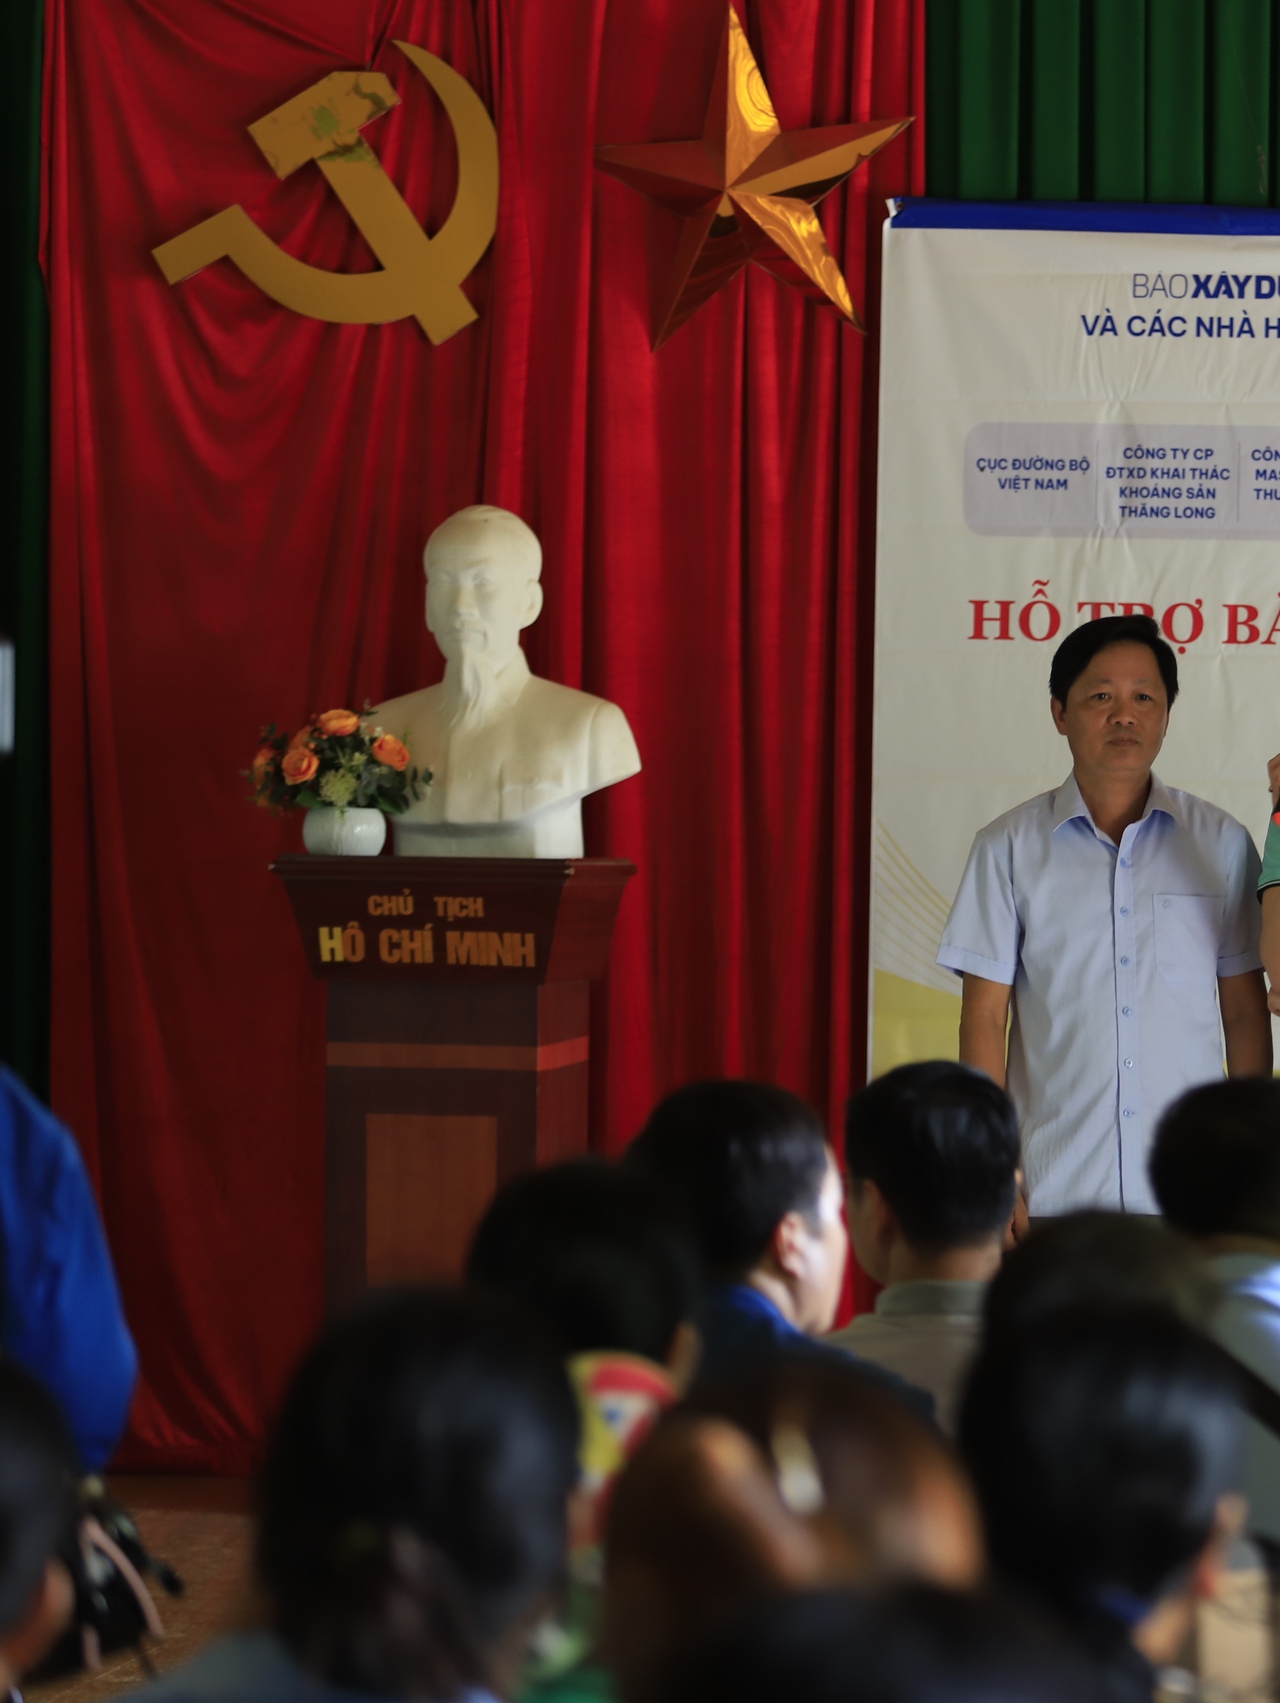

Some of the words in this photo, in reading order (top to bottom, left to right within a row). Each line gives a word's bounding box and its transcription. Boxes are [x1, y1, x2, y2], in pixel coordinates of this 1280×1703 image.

[1081, 308, 1118, 337] VÀ
[1127, 309, 1187, 338] CÁC
[1196, 309, 1255, 339] NHÀ
[1123, 446, 1167, 460] CÔNG
[1170, 449, 1190, 460] TY
[1193, 449, 1214, 461] CP
[976, 457, 1008, 474] CỤC
[1011, 456, 1066, 471] ĐƯỜNG
[1069, 456, 1090, 475] BỘ
[1105, 467, 1147, 479] ĐTXD
[1150, 468, 1186, 480] KHAI
[1189, 465, 1231, 481] THÁC
[998, 476, 1031, 493] VIỆT
[1034, 478, 1068, 490] NAM
[1119, 484, 1182, 500] KHOÁNG
[1185, 483, 1216, 500] SẢN
[1119, 503, 1170, 518] THĂNG
[1174, 507, 1216, 519] LONG
[967, 579, 1062, 642] HỖ
[367, 888, 414, 917] CHỦ
[433, 896, 485, 921] TỊCH
[379, 923, 434, 964] CHÍ
[446, 930, 536, 967] MINH
